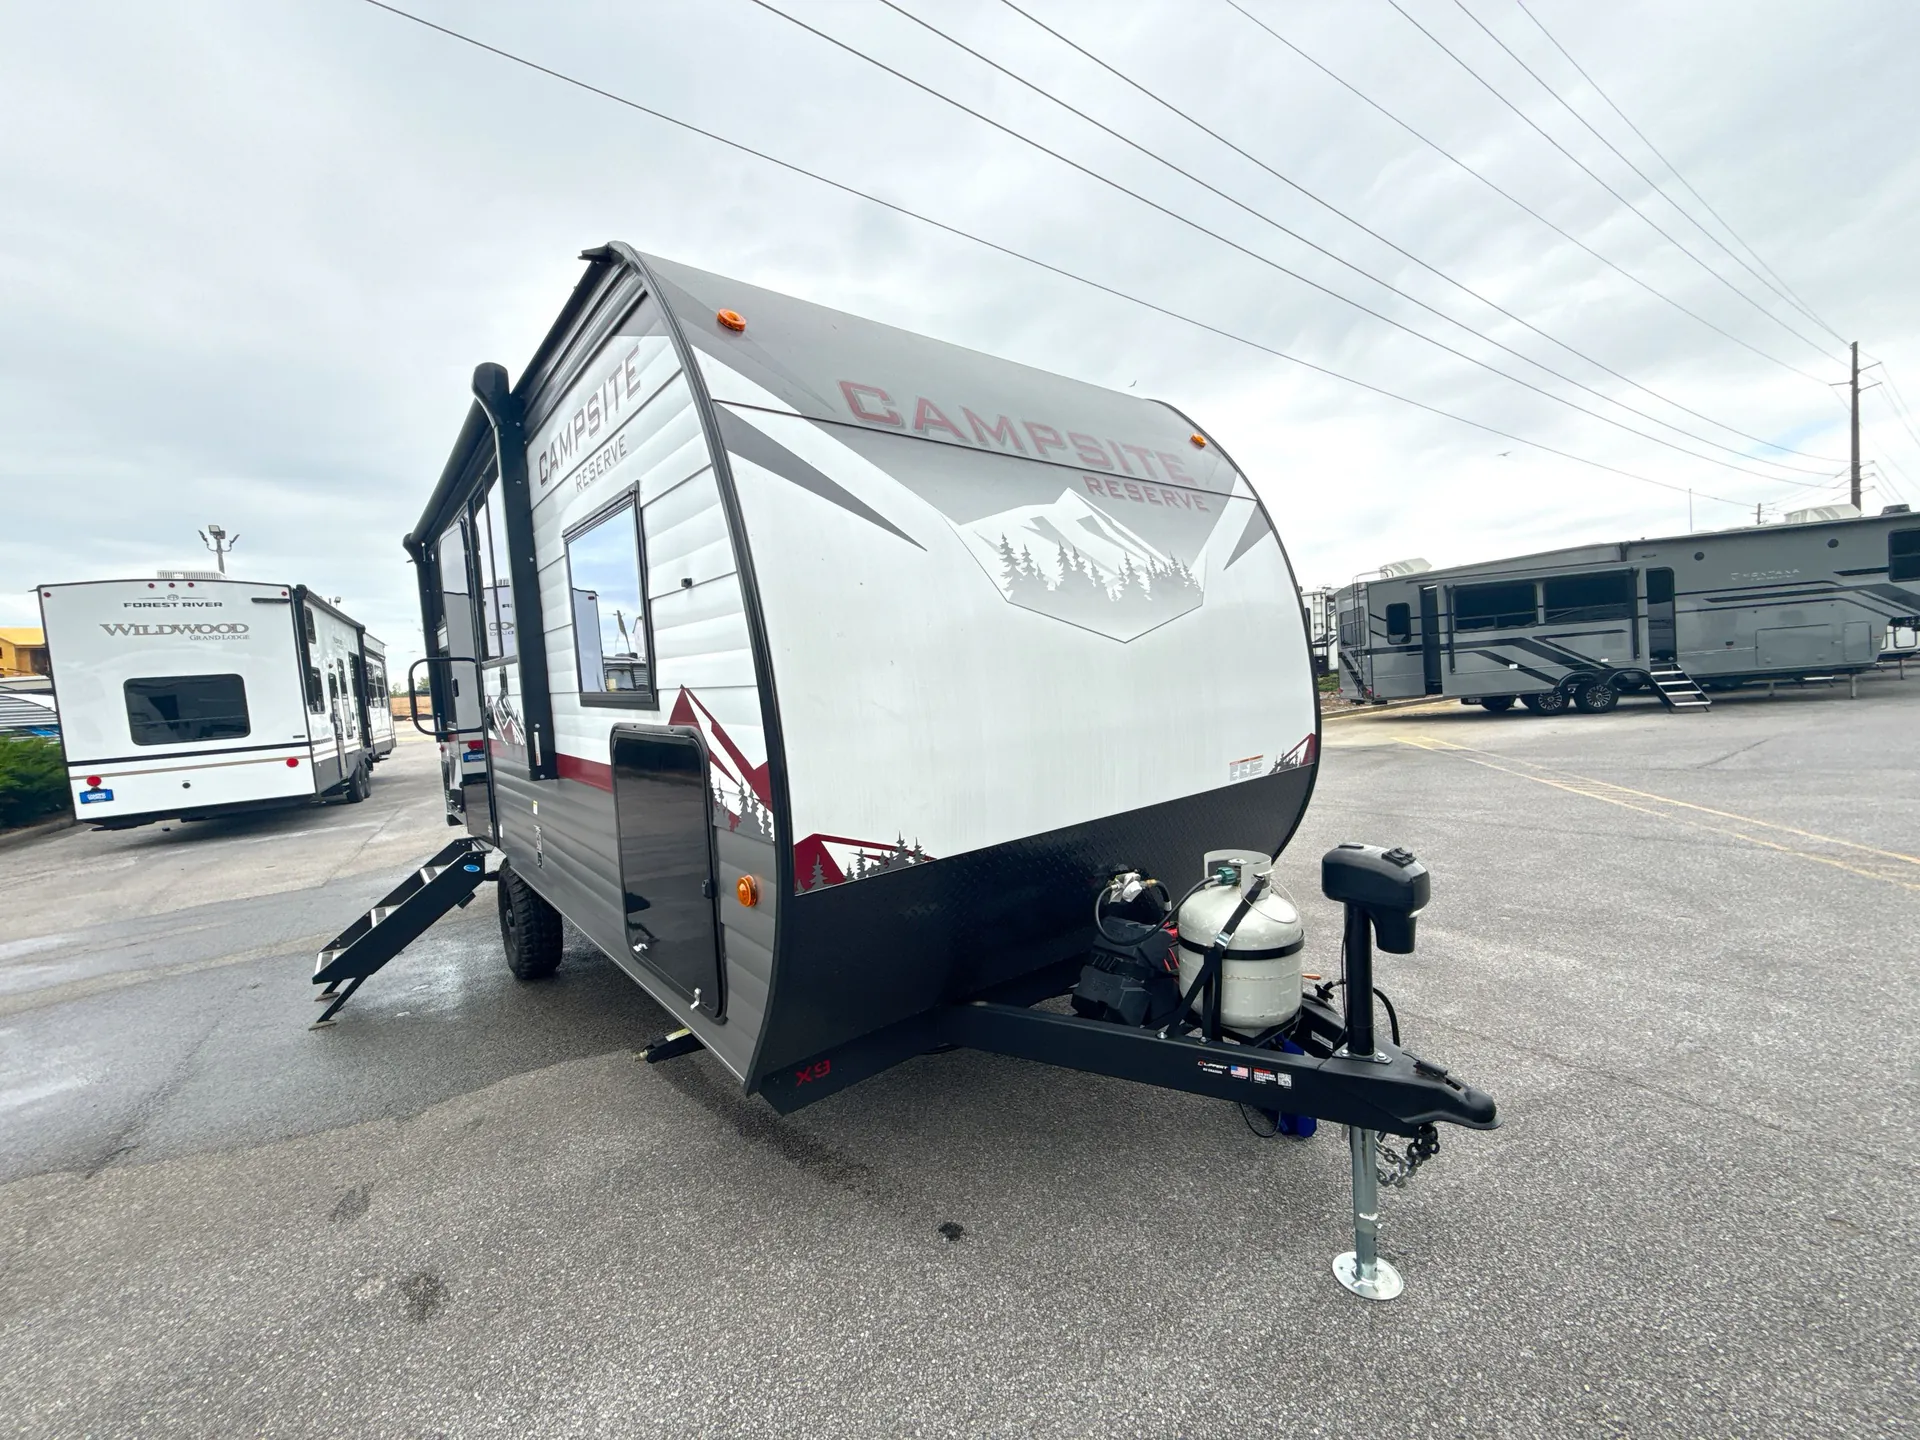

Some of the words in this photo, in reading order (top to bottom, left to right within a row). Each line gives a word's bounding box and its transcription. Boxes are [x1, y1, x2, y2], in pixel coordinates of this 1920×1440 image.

[539, 345, 641, 487] CAMPSITE
[838, 380, 1198, 487] CAMPSITE
[575, 434, 627, 492] RESERVE
[1083, 476, 1211, 511] RESERVE
[796, 1060, 831, 1087] X9
